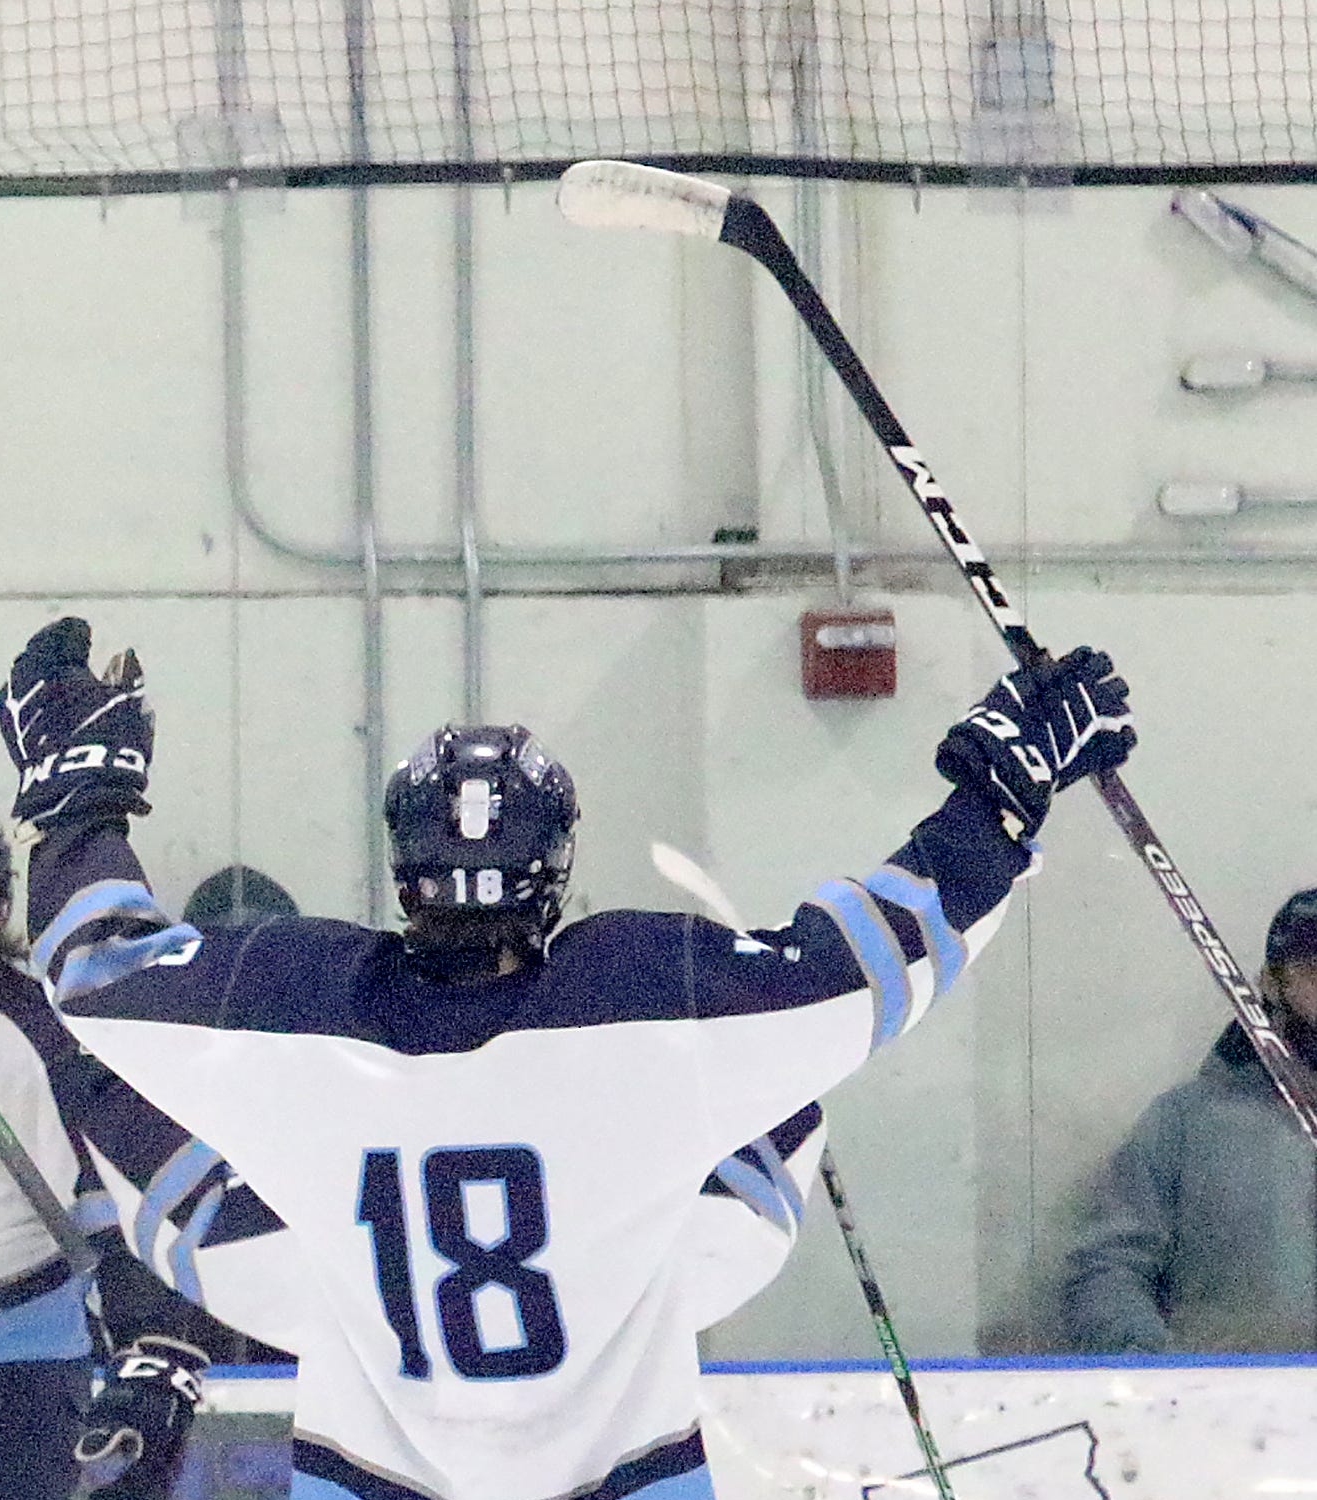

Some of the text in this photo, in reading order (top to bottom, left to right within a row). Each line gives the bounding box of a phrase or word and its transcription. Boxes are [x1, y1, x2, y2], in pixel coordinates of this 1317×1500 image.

[20, 744, 146, 794] CCM
[959, 706, 1062, 783] CC
[452, 868, 503, 904] 18
[1143, 843, 1290, 1058] JETSPEED
[354, 1142, 569, 1383] 18
